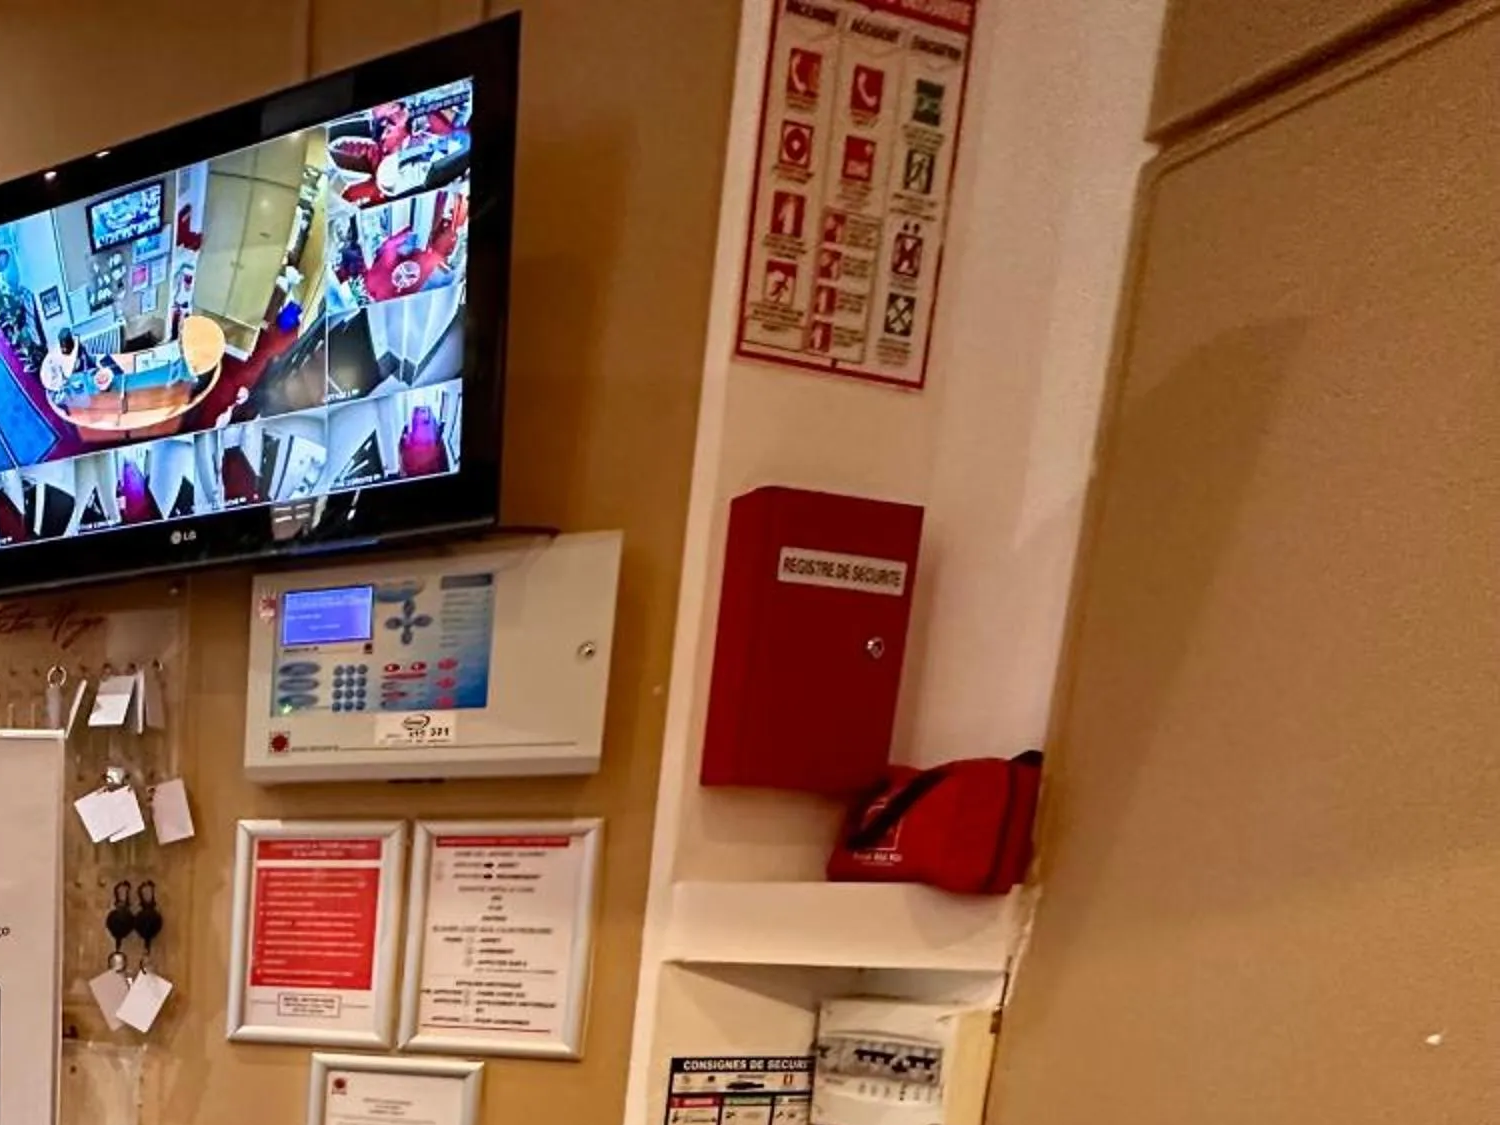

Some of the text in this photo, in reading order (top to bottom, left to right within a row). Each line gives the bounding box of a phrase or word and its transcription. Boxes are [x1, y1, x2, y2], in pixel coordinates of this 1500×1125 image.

[783, 557, 835, 577] REGISTRE
[836, 563, 851, 580] DE
[683, 1059, 747, 1071] CONSIGNES
[749, 1059, 765, 1070] DE
